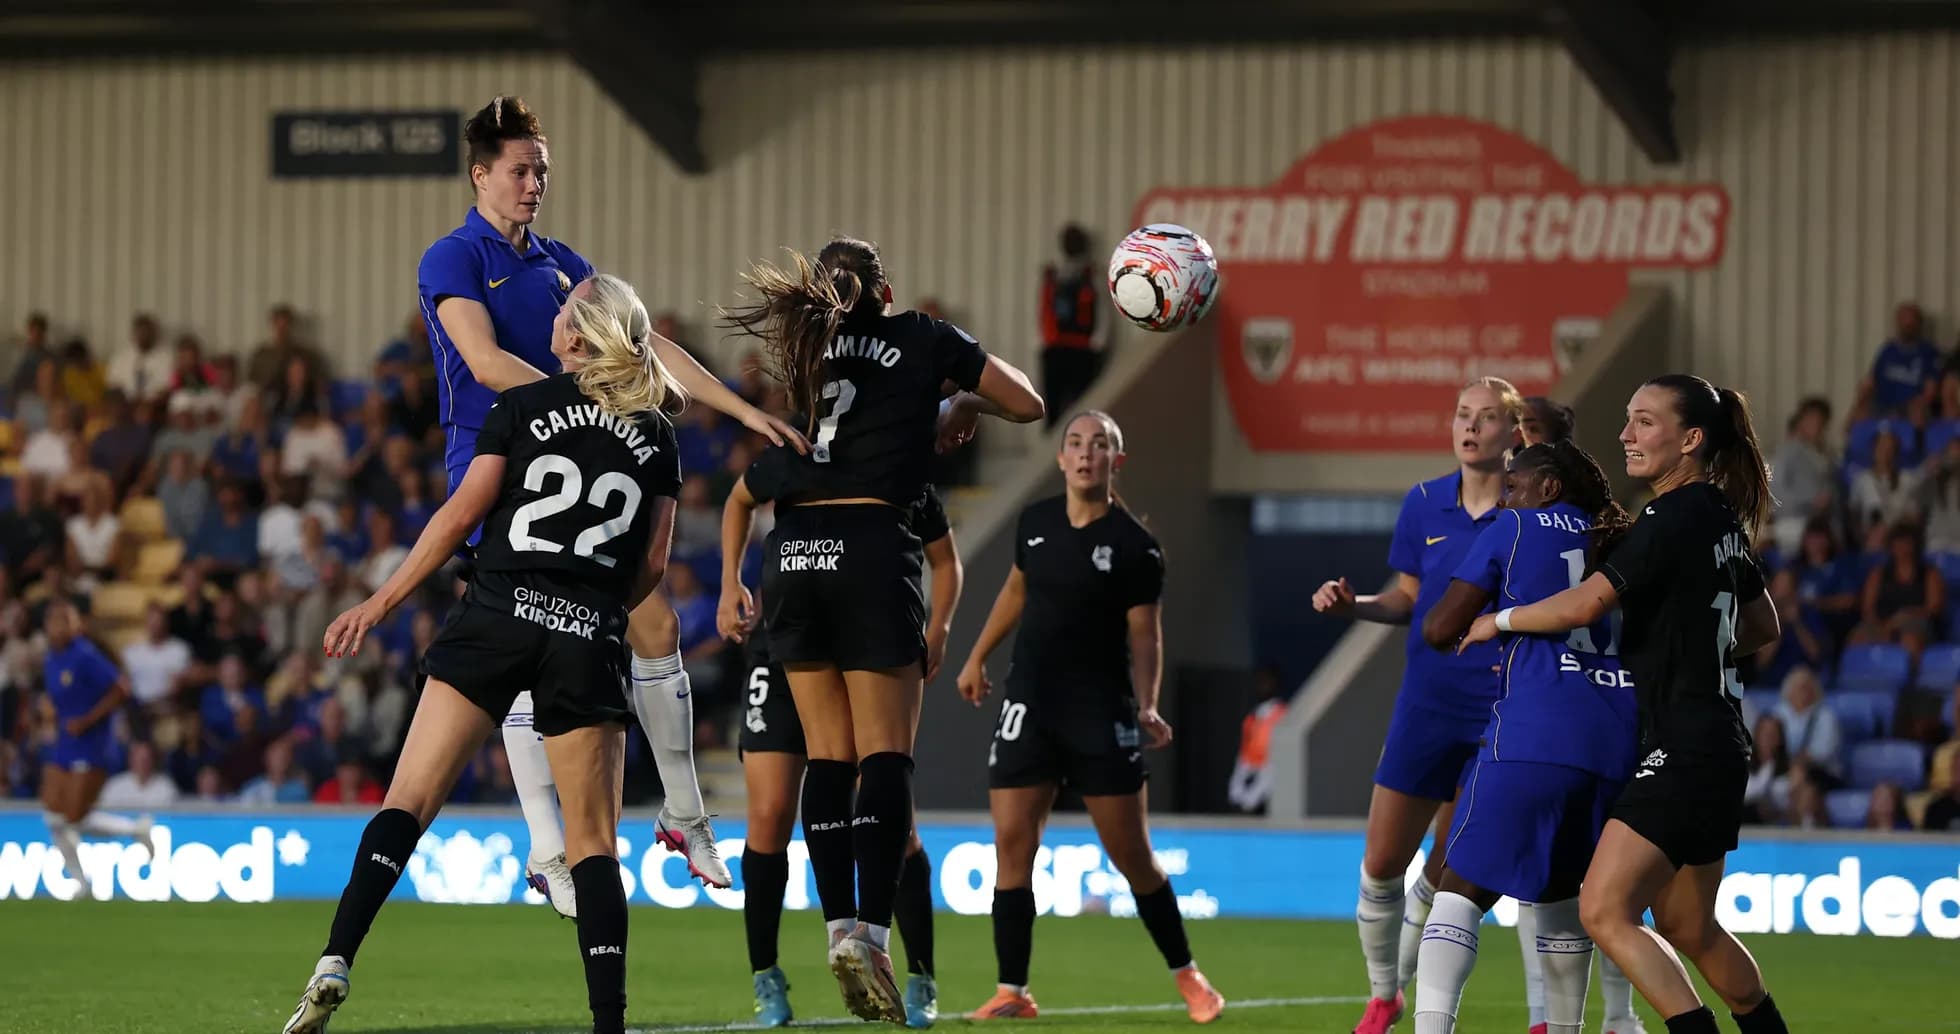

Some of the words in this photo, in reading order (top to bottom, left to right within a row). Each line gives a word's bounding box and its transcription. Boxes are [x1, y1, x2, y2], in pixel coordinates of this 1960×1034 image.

[1349, 195, 1460, 263] RED
[1462, 193, 1718, 264] RECORDS
[529, 404, 660, 466] CAHYNOVÁ
[508, 453, 643, 568] 22
[1536, 512, 1592, 534] BALT
[513, 602, 597, 641] KIROLAK
[514, 586, 600, 627] GIPUZKOA
[1559, 548, 1624, 656] 1
[749, 666, 770, 706] 5
[994, 698, 1027, 742] 0
[810, 820, 848, 831] REAL
[589, 945, 623, 957] REAL
